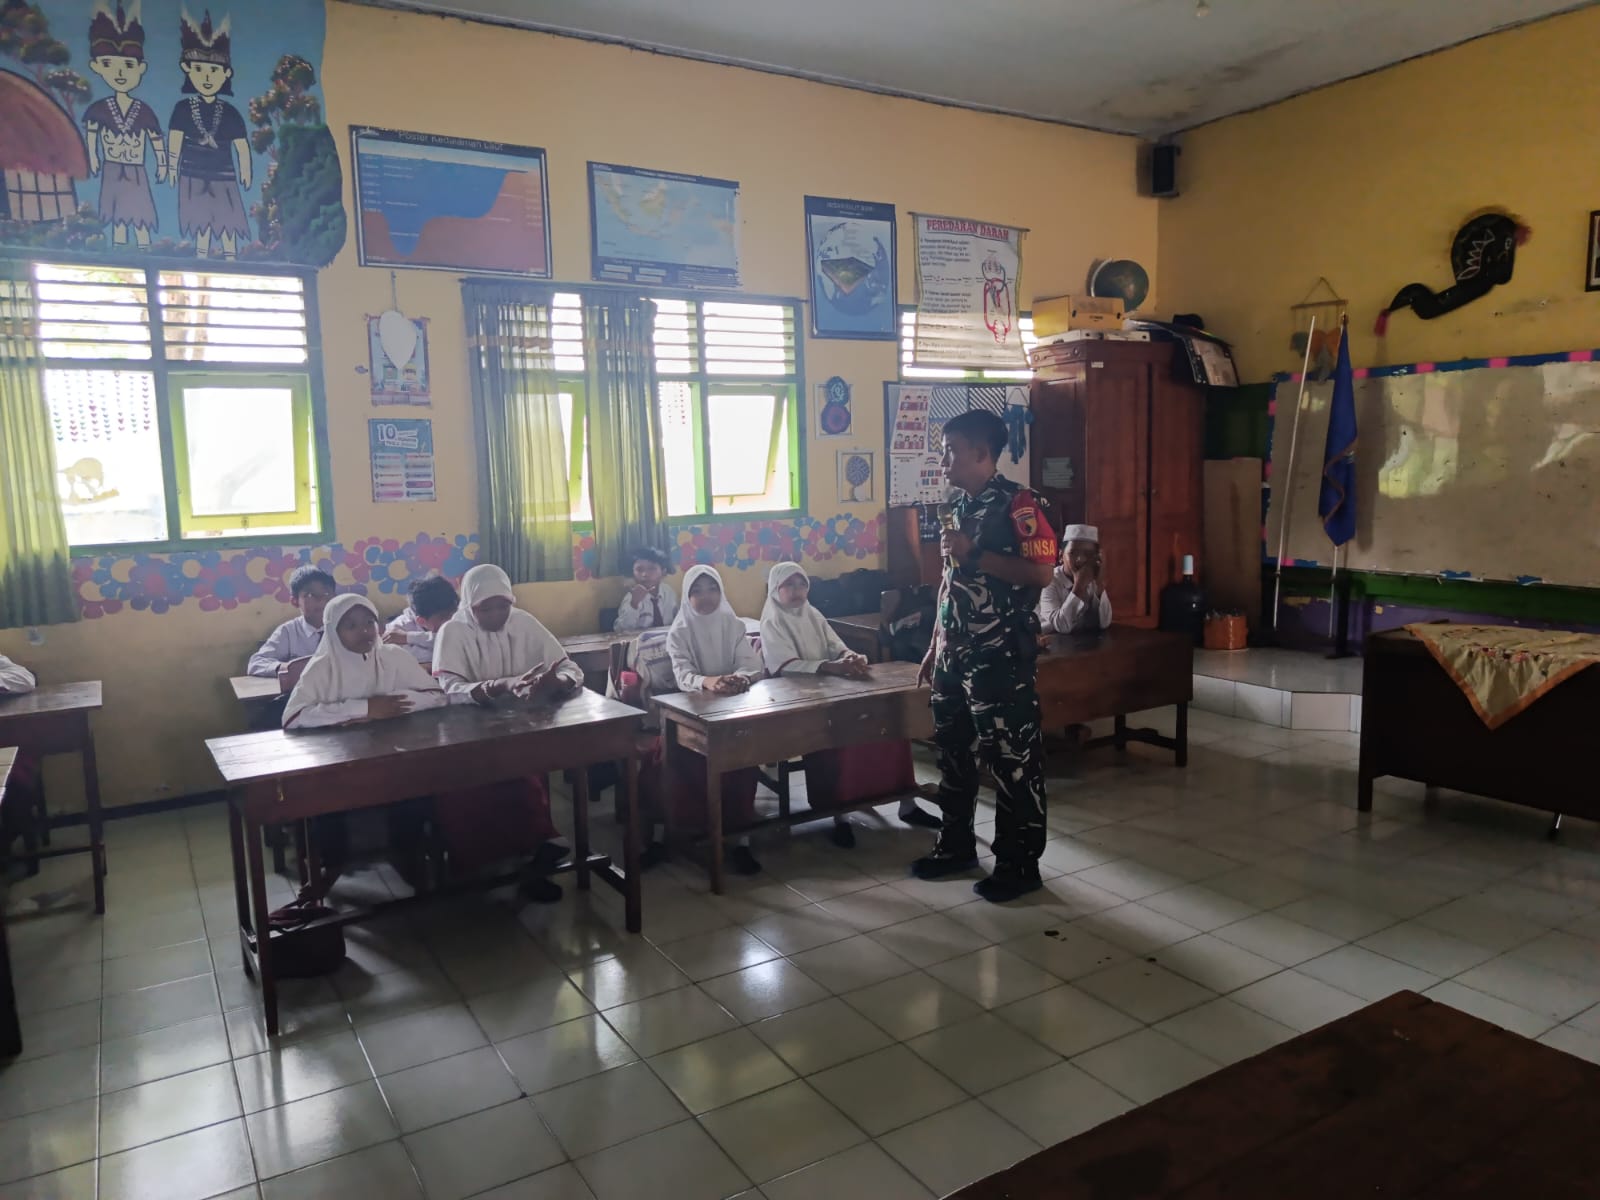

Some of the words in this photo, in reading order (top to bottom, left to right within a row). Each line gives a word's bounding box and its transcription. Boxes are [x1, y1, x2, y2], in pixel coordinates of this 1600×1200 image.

[926, 218, 977, 233] PEREDARAN
[979, 223, 1009, 241] DARAH
[378, 424, 397, 441] 10
[1019, 539, 1056, 558] BINSA
